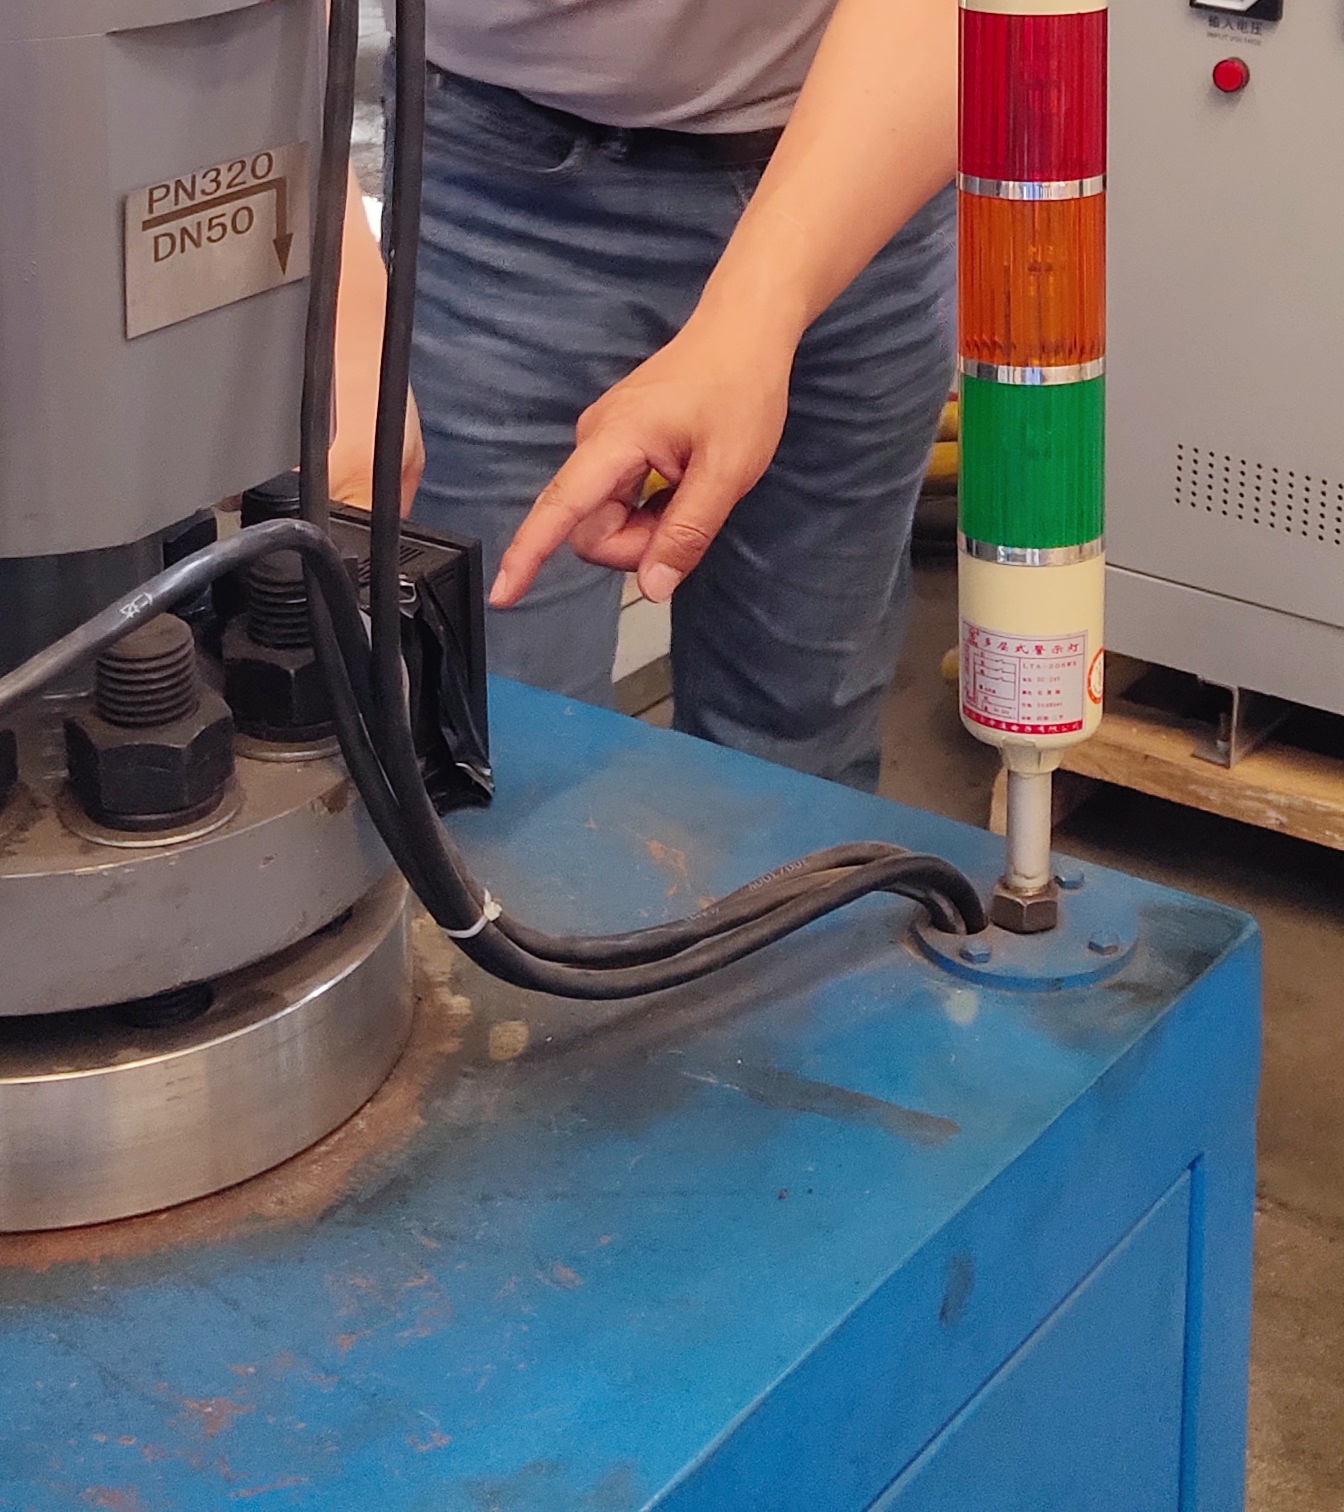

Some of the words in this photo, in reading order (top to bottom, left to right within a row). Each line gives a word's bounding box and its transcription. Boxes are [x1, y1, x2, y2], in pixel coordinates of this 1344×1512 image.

[1208, 14, 1263, 36] 输入电压
[148, 152, 274, 215] PN320
[154, 206, 254, 263] DN50
